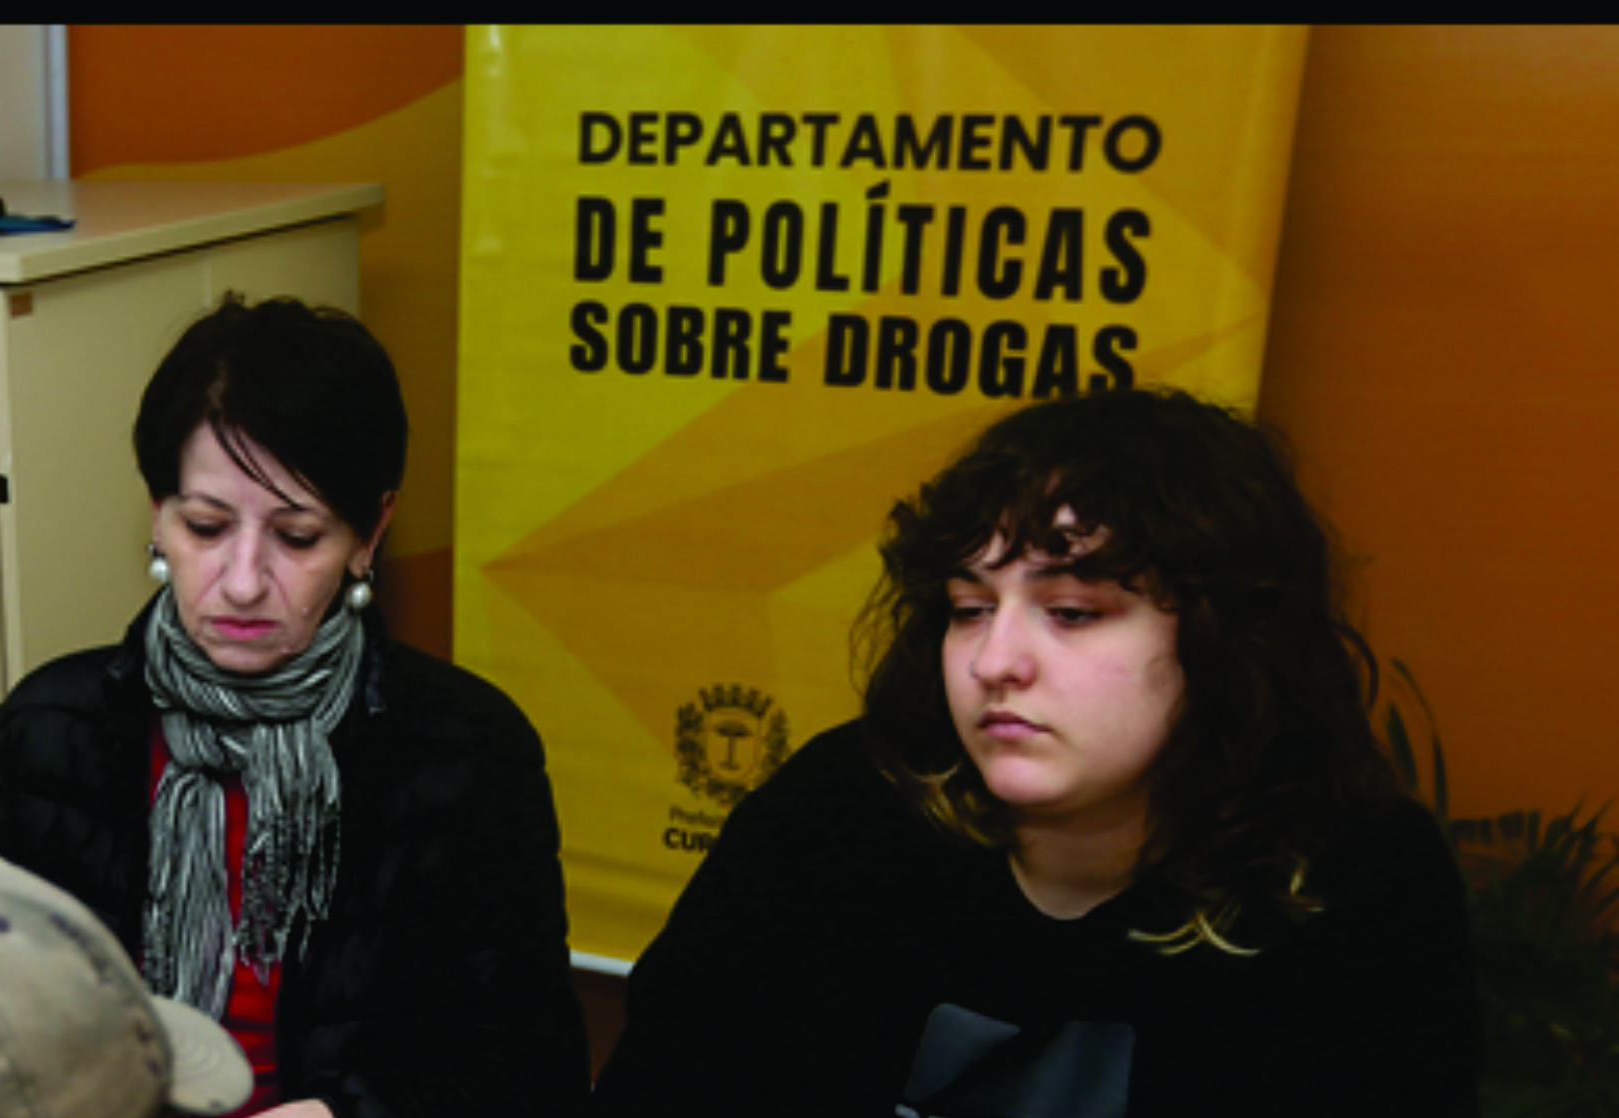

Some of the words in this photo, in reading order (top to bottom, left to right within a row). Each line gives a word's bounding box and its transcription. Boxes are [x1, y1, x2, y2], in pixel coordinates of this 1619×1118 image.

[579, 111, 1162, 173] DEPARTAMENTO
[573, 196, 665, 284] DE
[707, 178, 1151, 303] POLÍTICAS
[569, 301, 792, 383] SOBRE
[823, 313, 1139, 399] DROGAS
